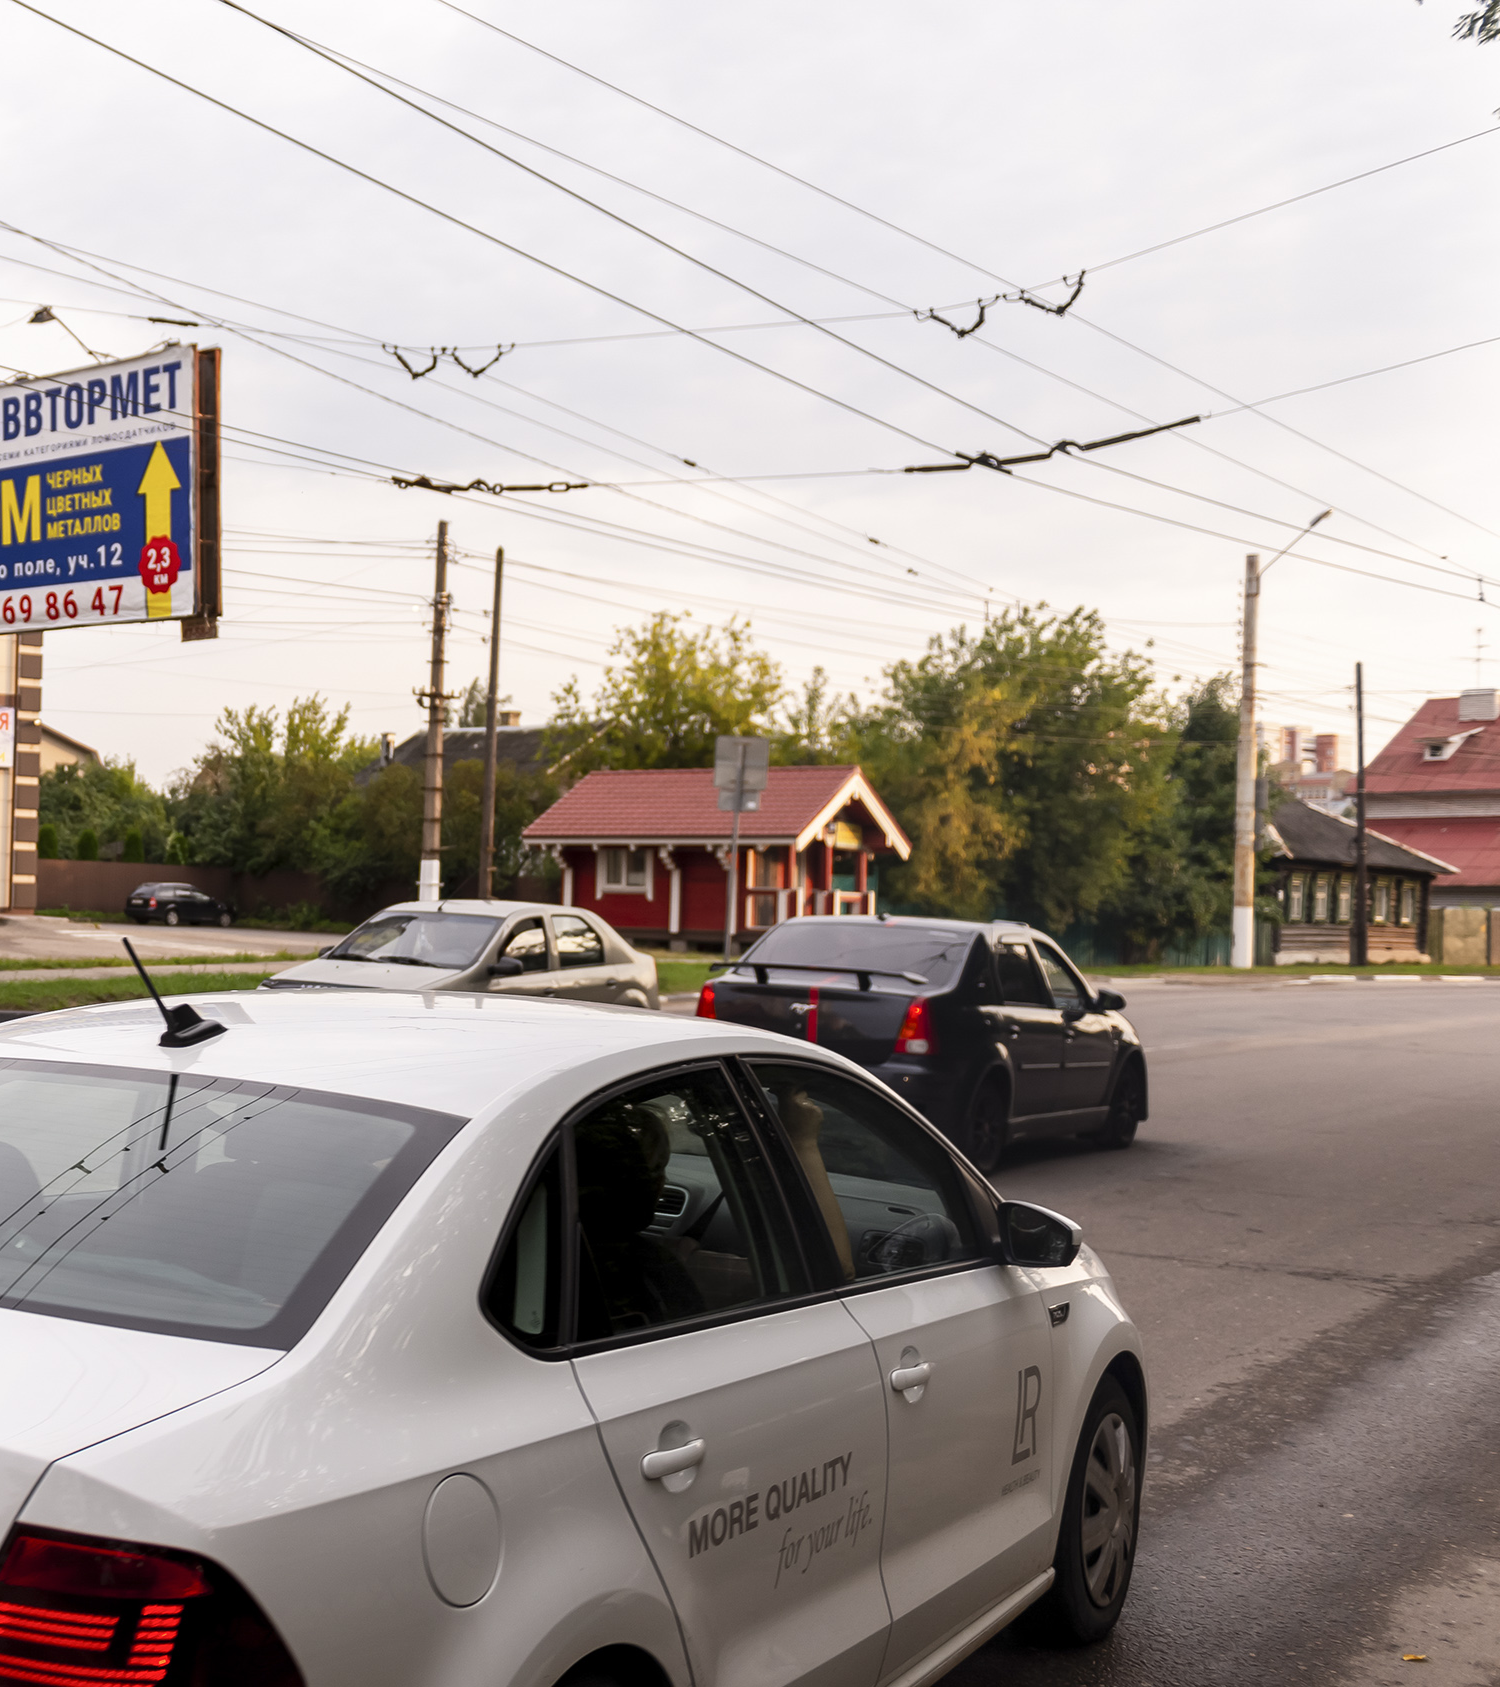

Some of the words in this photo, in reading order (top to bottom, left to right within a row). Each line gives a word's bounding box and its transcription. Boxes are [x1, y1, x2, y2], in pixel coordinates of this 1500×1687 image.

[24, 438, 88, 456] КАТЕГОРИЯМИ
[46, 464, 103, 489] ЧЕРНЫХ
[46, 488, 113, 517] ЦВЕТНЫХ
[46, 513, 121, 540] МЕТАЛЛОВ
[14, 557, 61, 577] поле,
[147, 546, 171, 572] 2,3
[45, 589, 78, 620] 86
[91, 585, 124, 616] 47
[689, 1493, 759, 1559] MORE
[765, 1451, 852, 1521] QUALITY
[774, 1527, 805, 1589] for
[802, 1515, 845, 1574] your
[844, 1490, 872, 1548] life.
